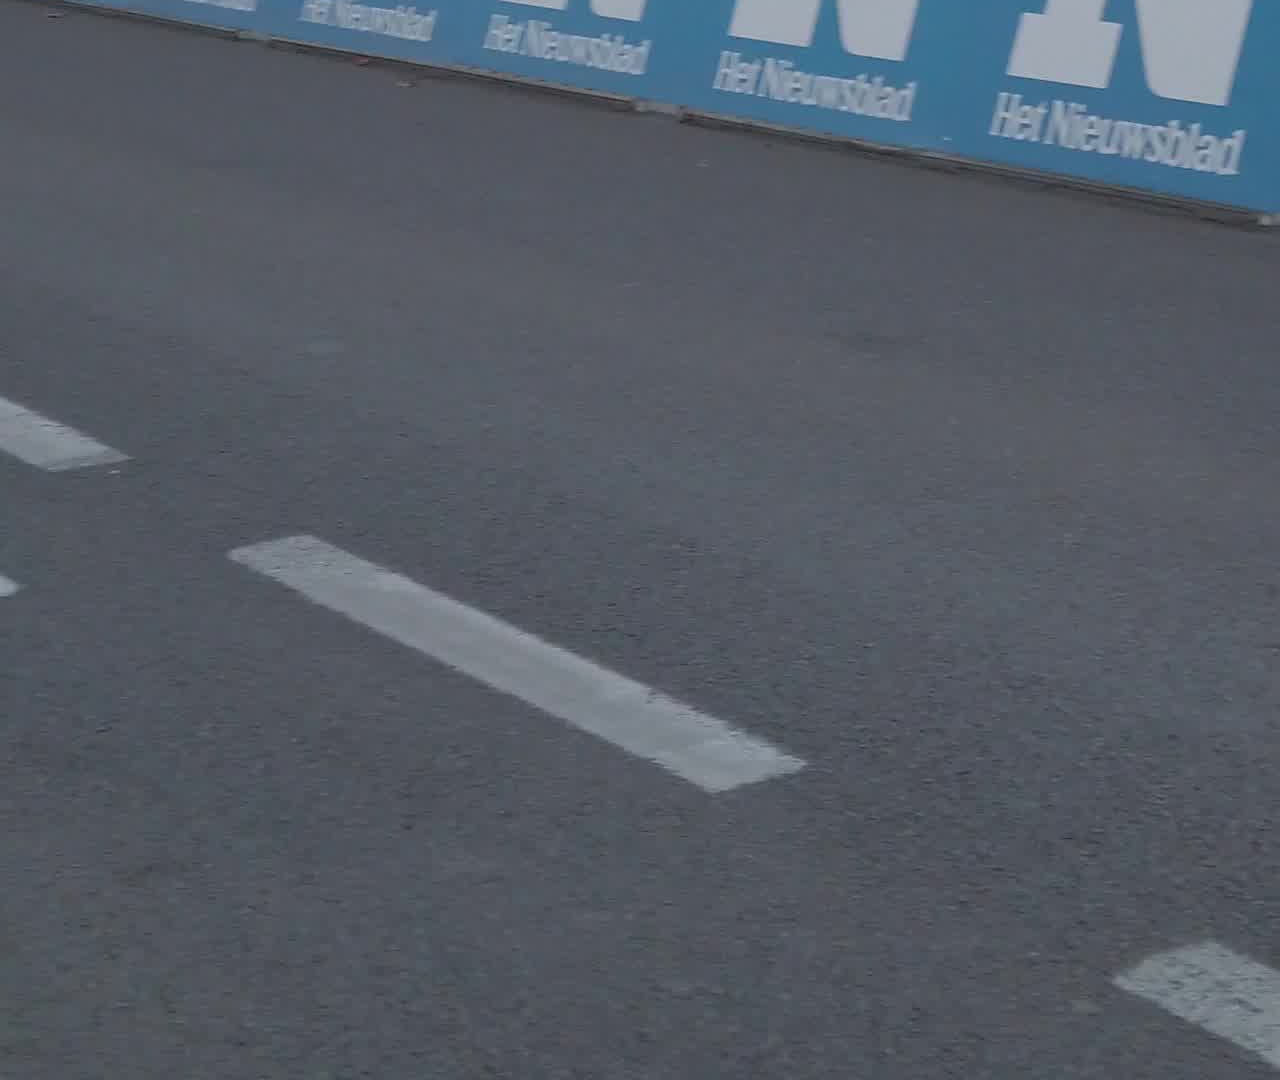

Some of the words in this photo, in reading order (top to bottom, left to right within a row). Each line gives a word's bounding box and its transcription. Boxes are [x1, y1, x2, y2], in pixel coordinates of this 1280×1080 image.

[483, 14, 526, 55] Het
[521, 18, 652, 75] Nieuwsblad
[712, 50, 762, 97] Het
[758, 57, 917, 121] Nieuwsblad
[988, 92, 1048, 142] Het
[1042, 100, 1246, 174] Nieuwsblad
